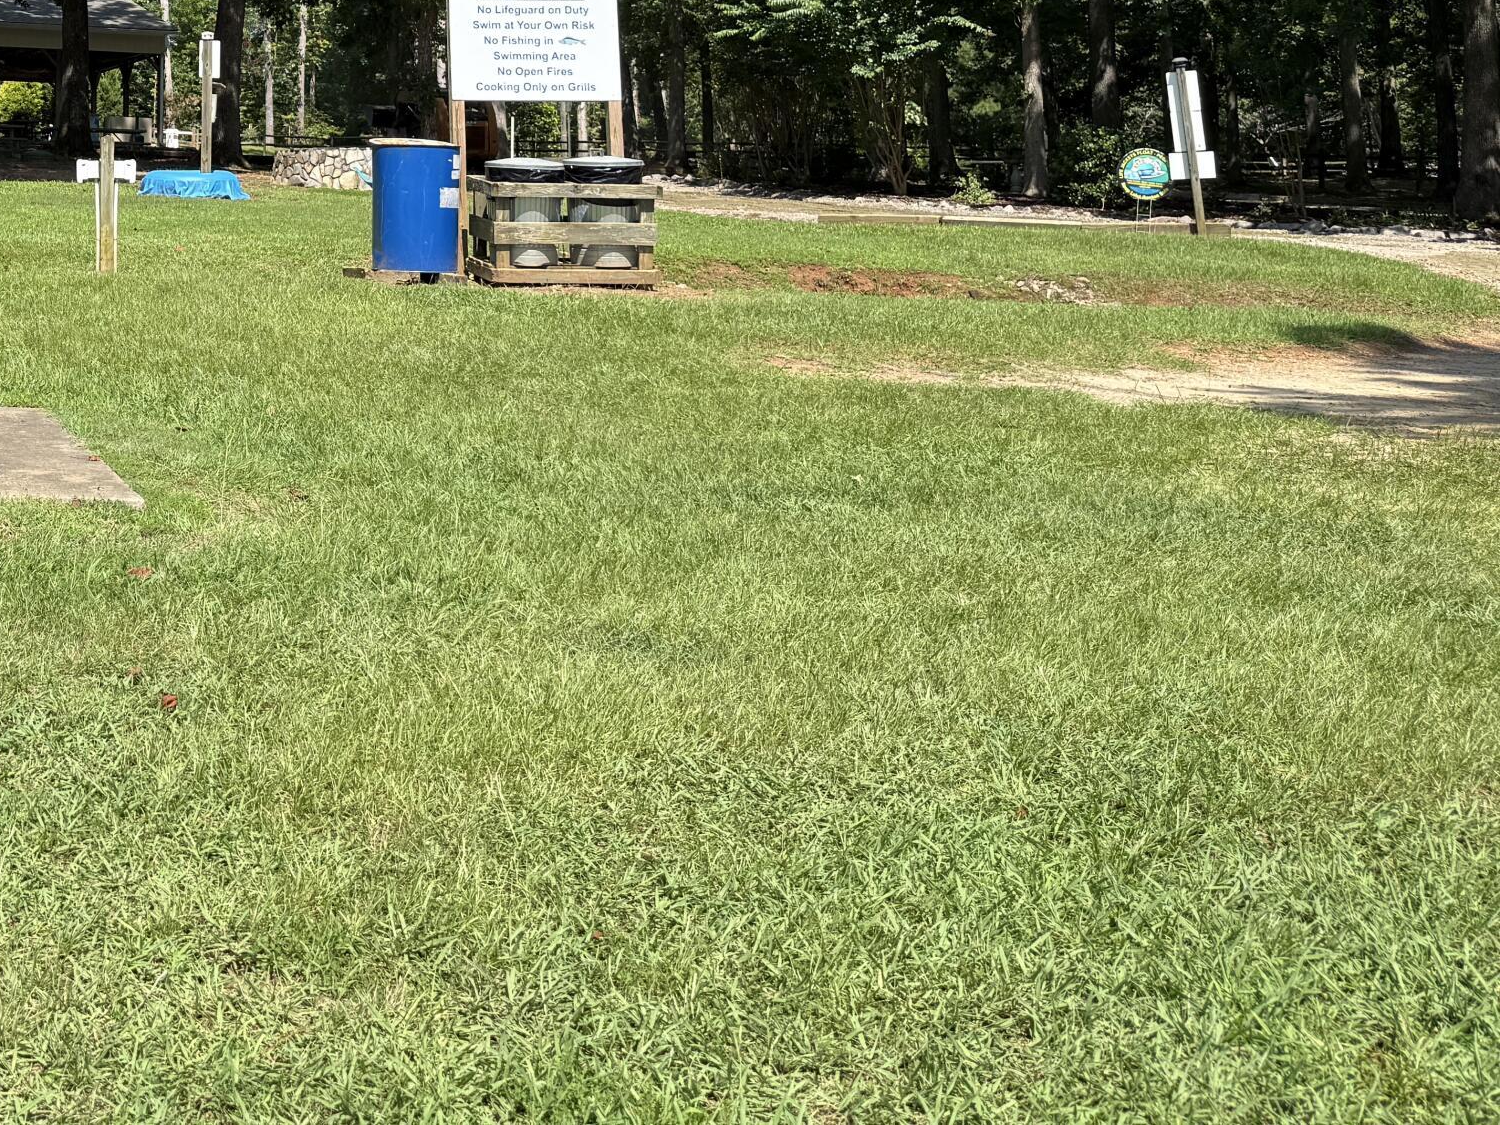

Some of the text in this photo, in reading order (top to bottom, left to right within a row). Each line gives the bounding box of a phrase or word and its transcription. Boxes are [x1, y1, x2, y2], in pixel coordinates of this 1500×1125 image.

[478, 6, 492, 15] No
[496, 6, 545, 17] Lifeguard
[565, 6, 589, 17] Duty
[473, 21, 595, 30] Swim at Your Own Risk
[484, 36, 554, 47] No Fishing in
[494, 52, 576, 63] Swimming Area
[498, 67, 573, 78] No Open Fires
[476, 83, 520, 94] Cooking
[524, 83, 548, 94] Only
[568, 83, 597, 92] Grills
